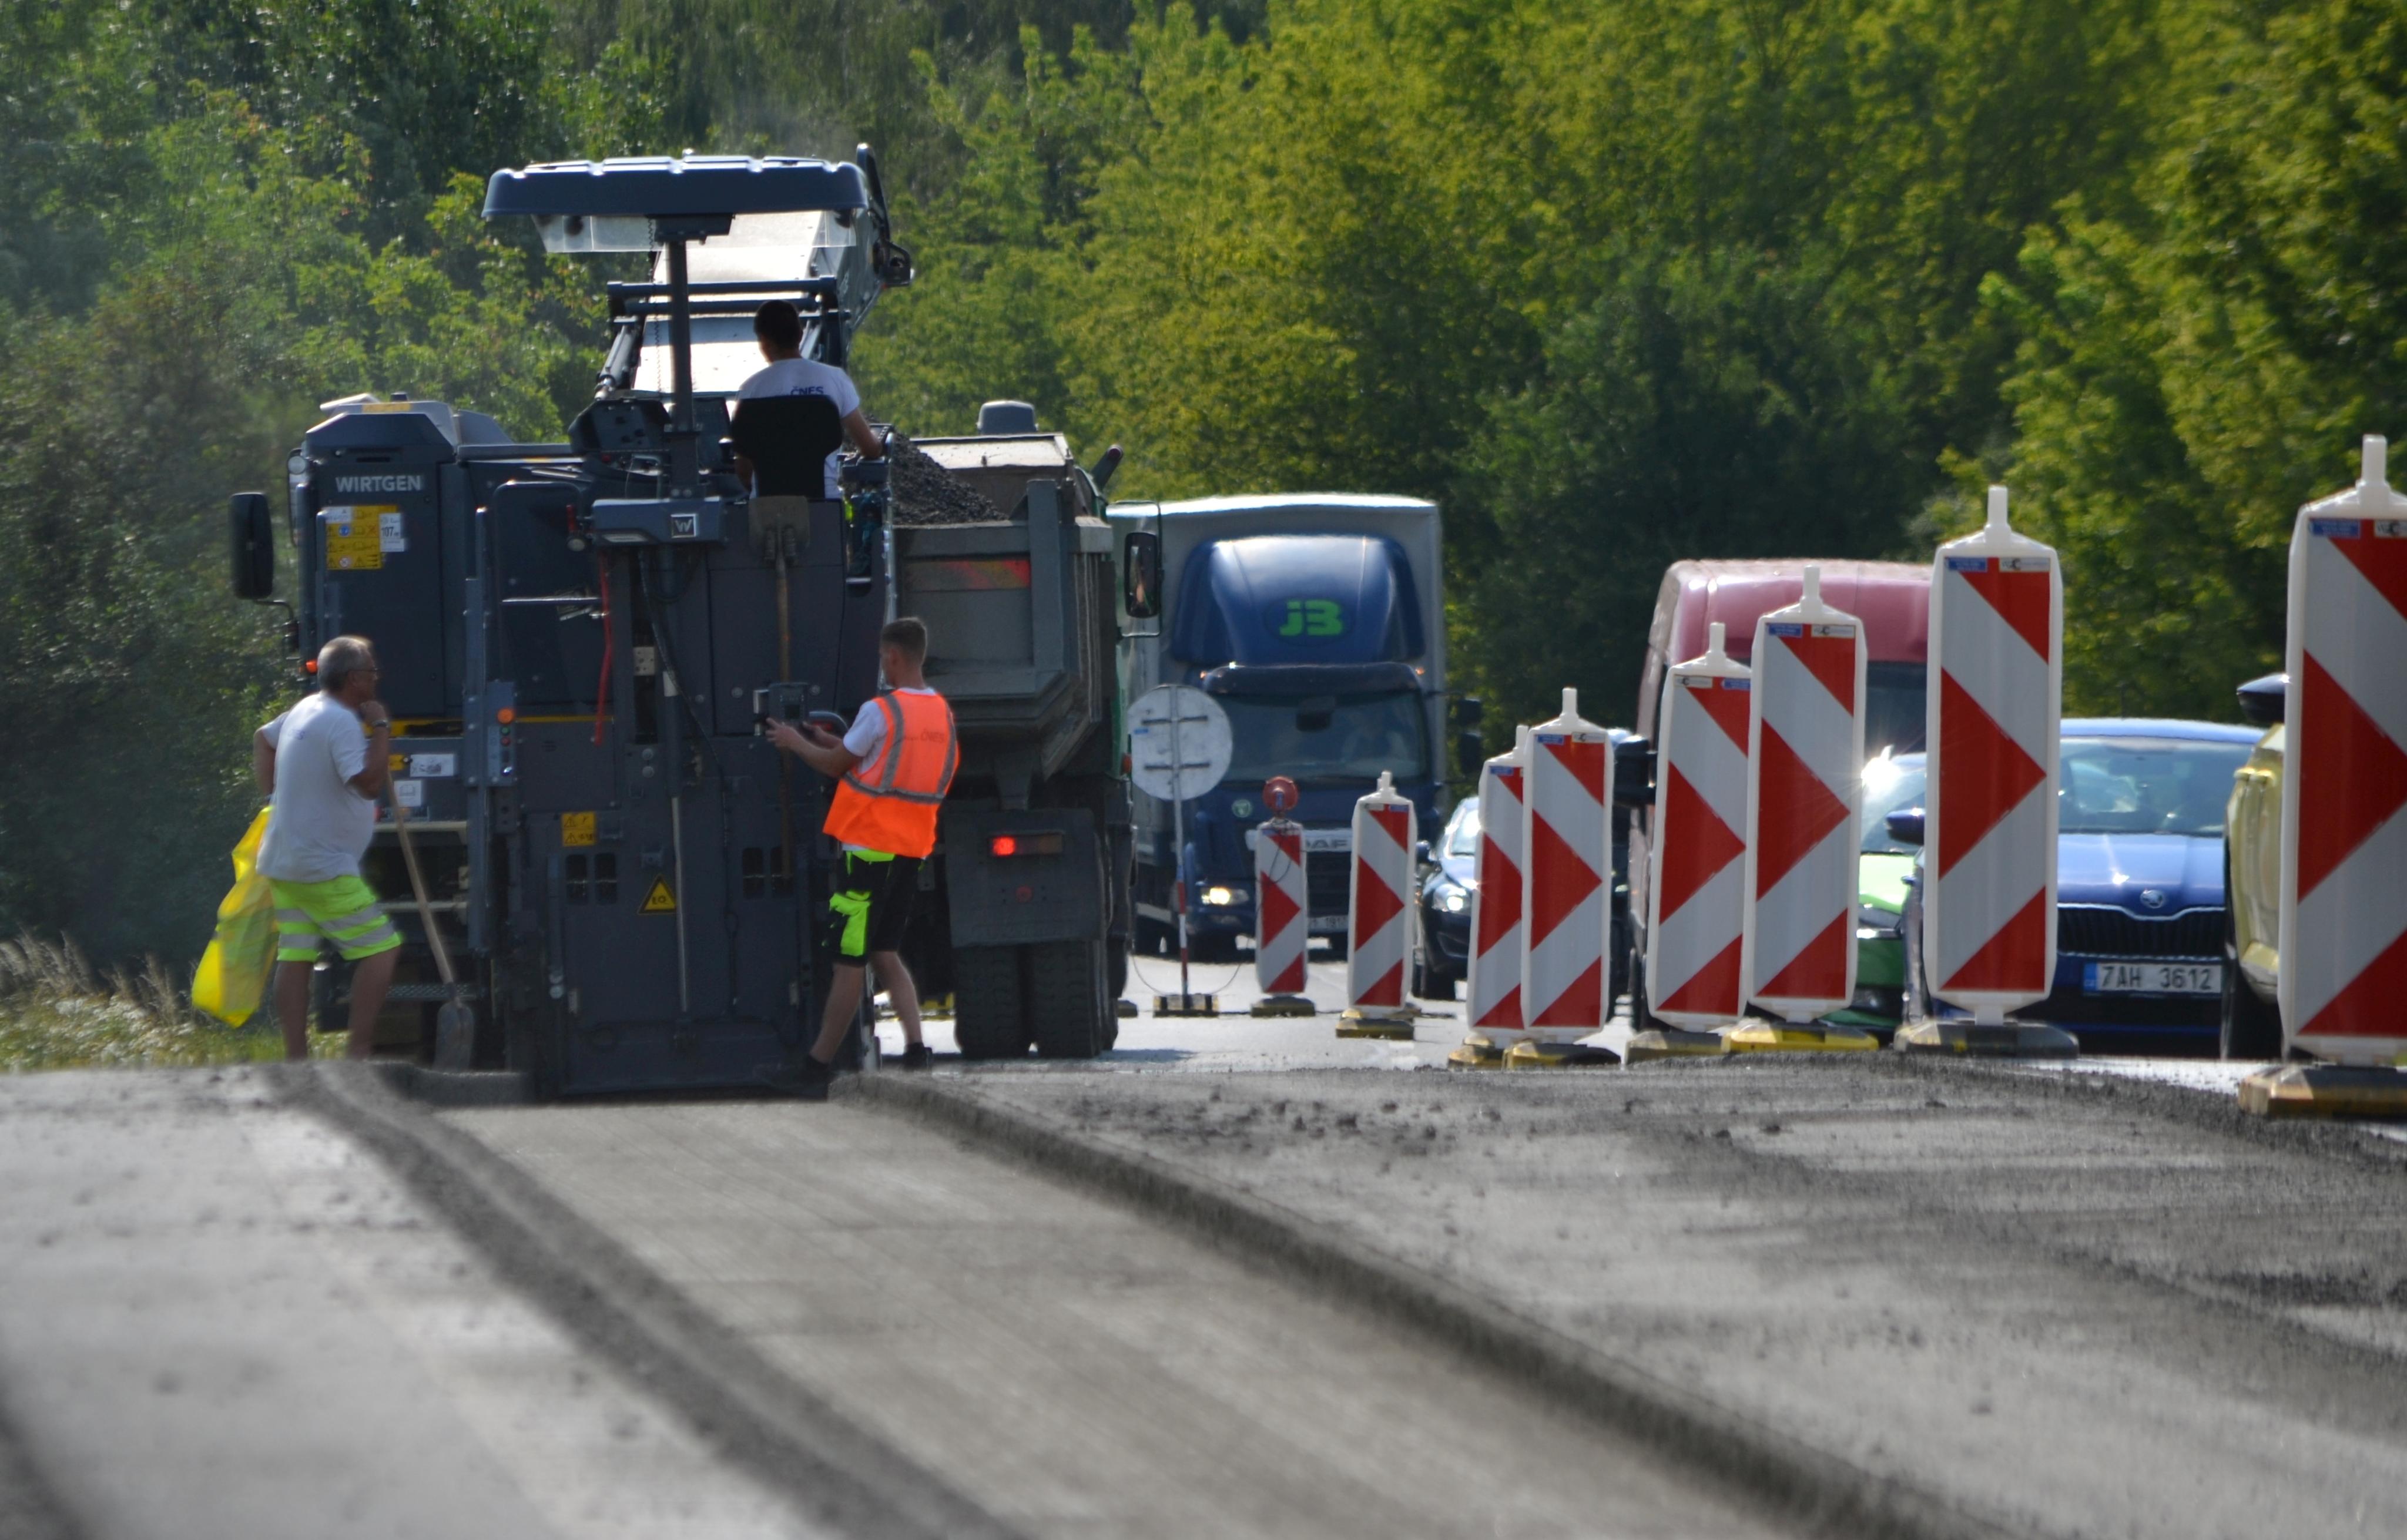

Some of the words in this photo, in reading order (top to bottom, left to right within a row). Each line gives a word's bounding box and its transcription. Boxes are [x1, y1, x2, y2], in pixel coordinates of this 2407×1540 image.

[336, 475, 421, 492] WIRTGEN
[2102, 966, 2141, 988] 7AH
[2160, 968, 2212, 990] 3612
